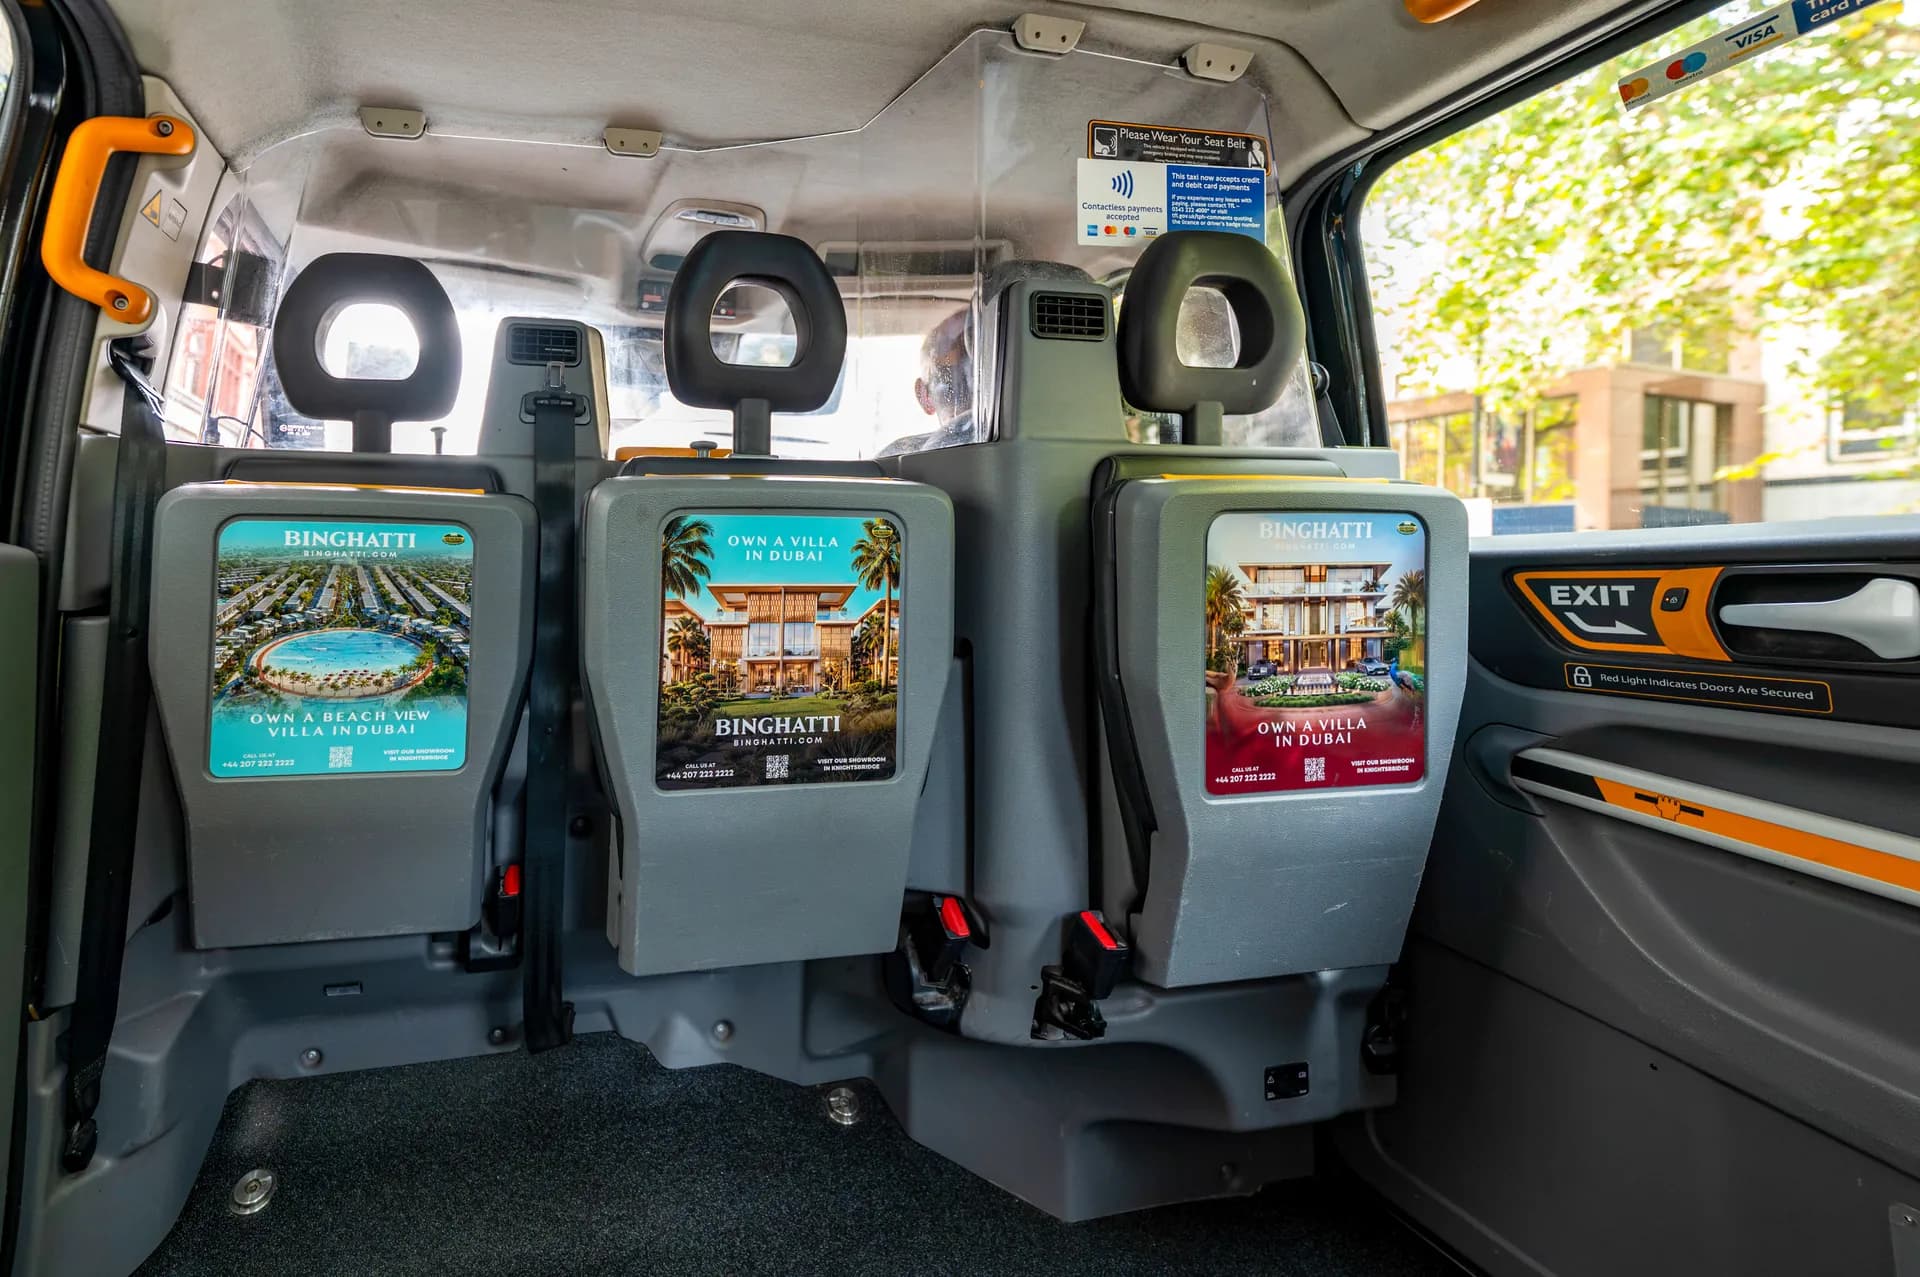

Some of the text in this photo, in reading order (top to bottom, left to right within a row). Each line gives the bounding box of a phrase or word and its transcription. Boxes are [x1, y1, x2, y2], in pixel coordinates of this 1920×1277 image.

[1810, 0, 1849, 22] card
[1735, 24, 1776, 49] VISA
[1120, 128, 1246, 149] Please Wear Your Seat Belt
[1172, 172, 1186, 180] This
[1185, 181, 1202, 189] debit
[1082, 202, 1163, 214] Contactless payments
[1106, 213, 1140, 222] accepted
[1260, 522, 1374, 540] BINGHATTI
[284, 530, 416, 548] BINGHATTI
[728, 535, 839, 548] OWN A VILLA
[304, 550, 398, 558] BINGHATTI.COM
[745, 550, 823, 562] IN DUBAI
[1550, 584, 1635, 607] EXIT
[1600, 673, 1814, 701] Red Light Indicates Doors Are Secured
[250, 710, 430, 725] OWN A BEACH VIEW
[268, 724, 415, 737] VILLA IN DUBAI
[715, 716, 841, 737] BINGHATTI
[1257, 717, 1367, 735] OWN A VILLA
[734, 737, 823, 747] BINGHATTI.COM
[1276, 732, 1352, 748] IN DUBAI
[682, 771, 698, 779] 207
[699, 770, 714, 778] 222
[715, 769, 734, 778] 2222
[1230, 775, 1243, 783] 207
[1244, 774, 1258, 782] 222
[1259, 772, 1276, 781] 2222
